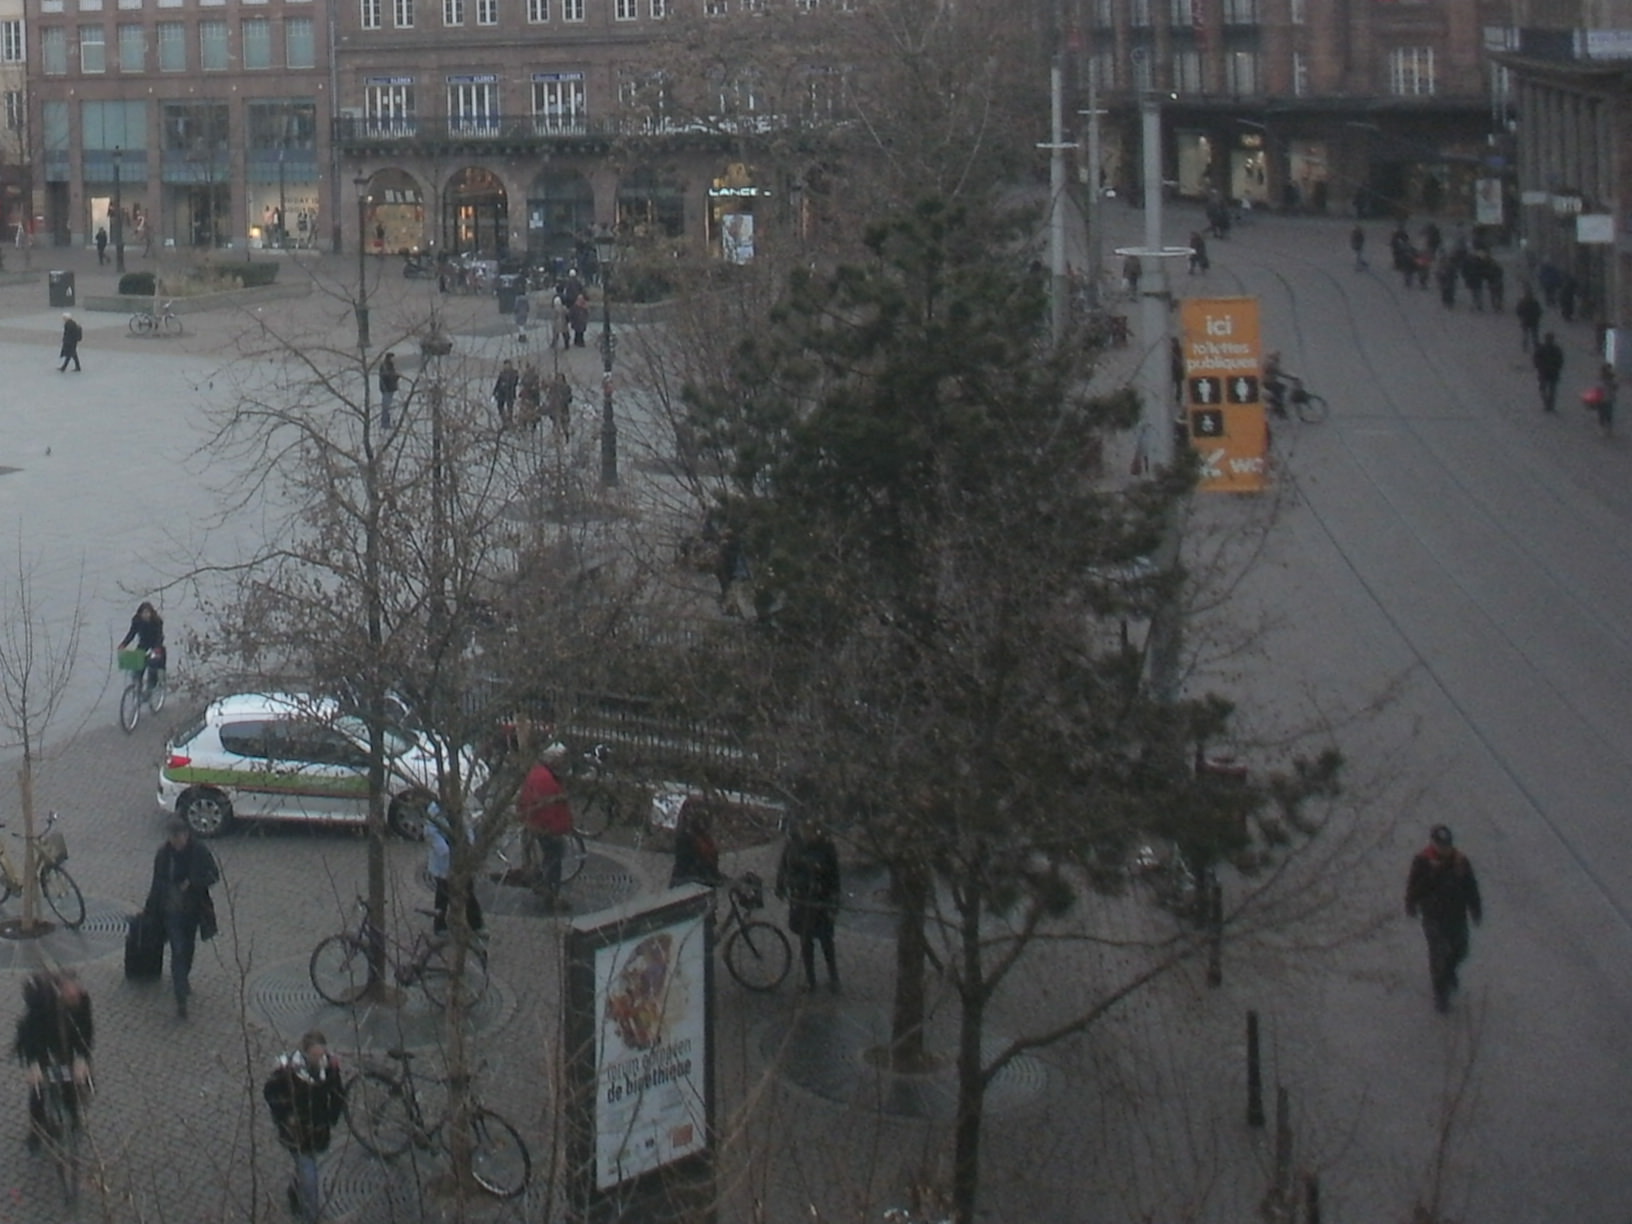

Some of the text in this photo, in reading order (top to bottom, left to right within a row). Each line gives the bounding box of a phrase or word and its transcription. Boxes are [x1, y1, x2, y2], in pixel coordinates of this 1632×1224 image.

[1206, 315, 1233, 336] ici
[1192, 340, 1250, 355] toilettes
[1186, 356, 1259, 372] publiques
[607, 1081, 623, 1105] de
